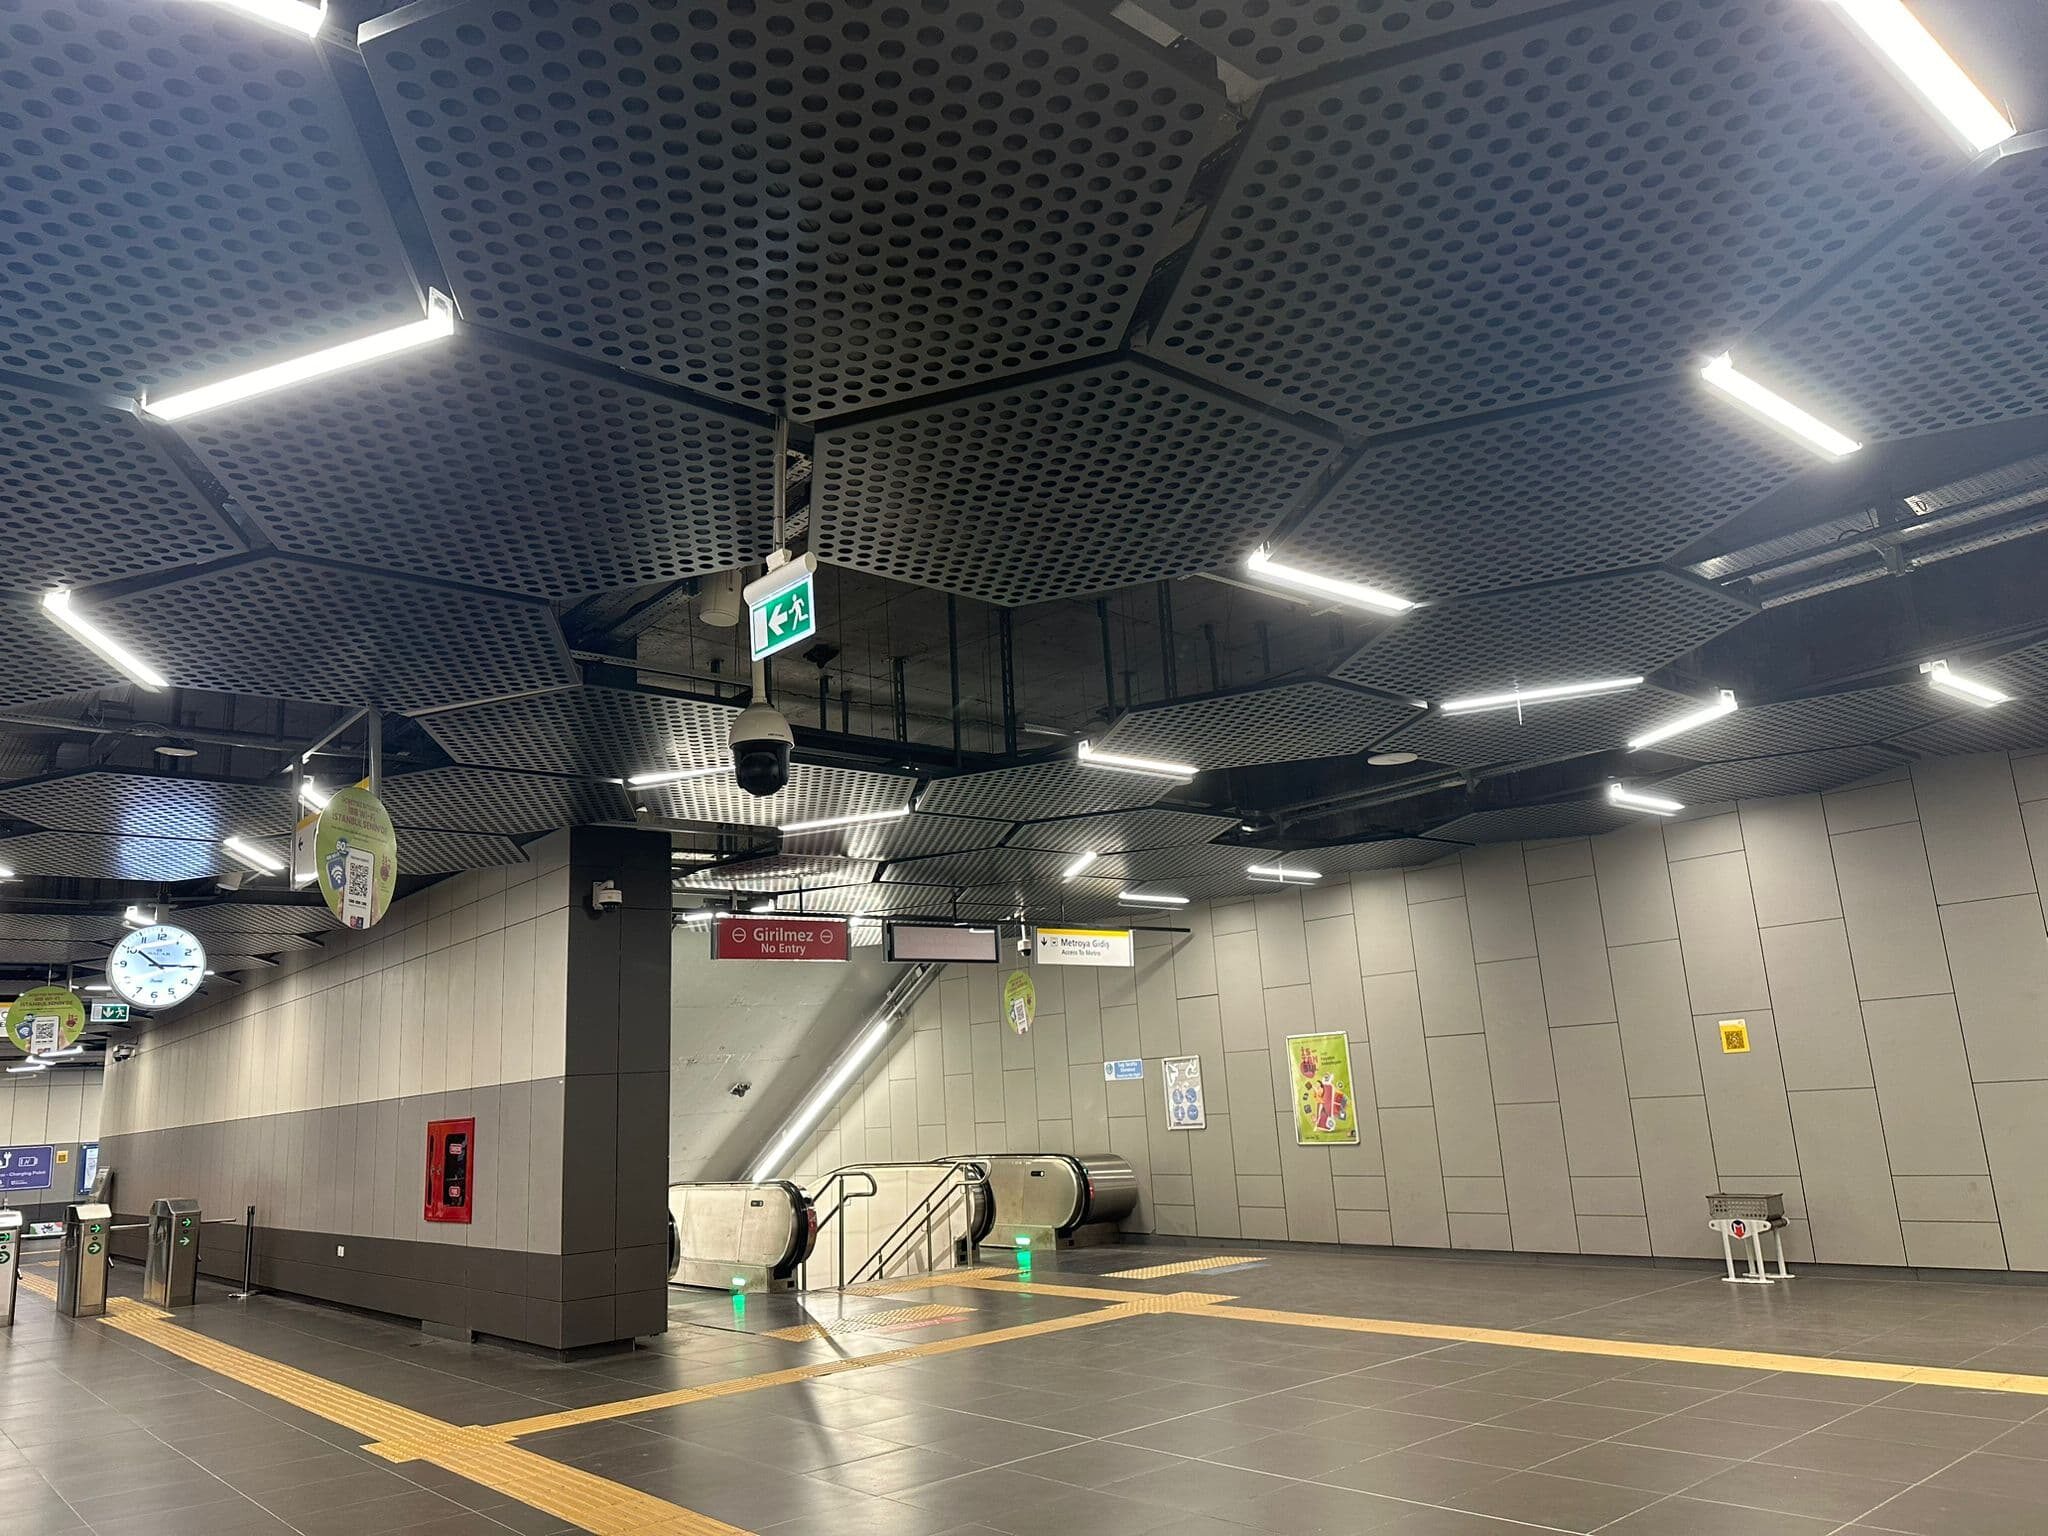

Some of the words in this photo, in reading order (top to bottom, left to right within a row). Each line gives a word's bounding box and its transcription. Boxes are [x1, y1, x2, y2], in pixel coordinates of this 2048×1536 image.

[157, 933, 168, 941] 12
[753, 927, 814, 942] Girilmez
[1061, 938, 1090, 949] Metroya
[184, 948, 192, 956] 2
[761, 943, 776, 953] No
[779, 943, 806, 956] Entry
[120, 960, 127, 968] 9
[181, 977, 188, 985] 4
[136, 986, 143, 994] 7
[168, 987, 175, 995] 5
[150, 991, 158, 999] 6
